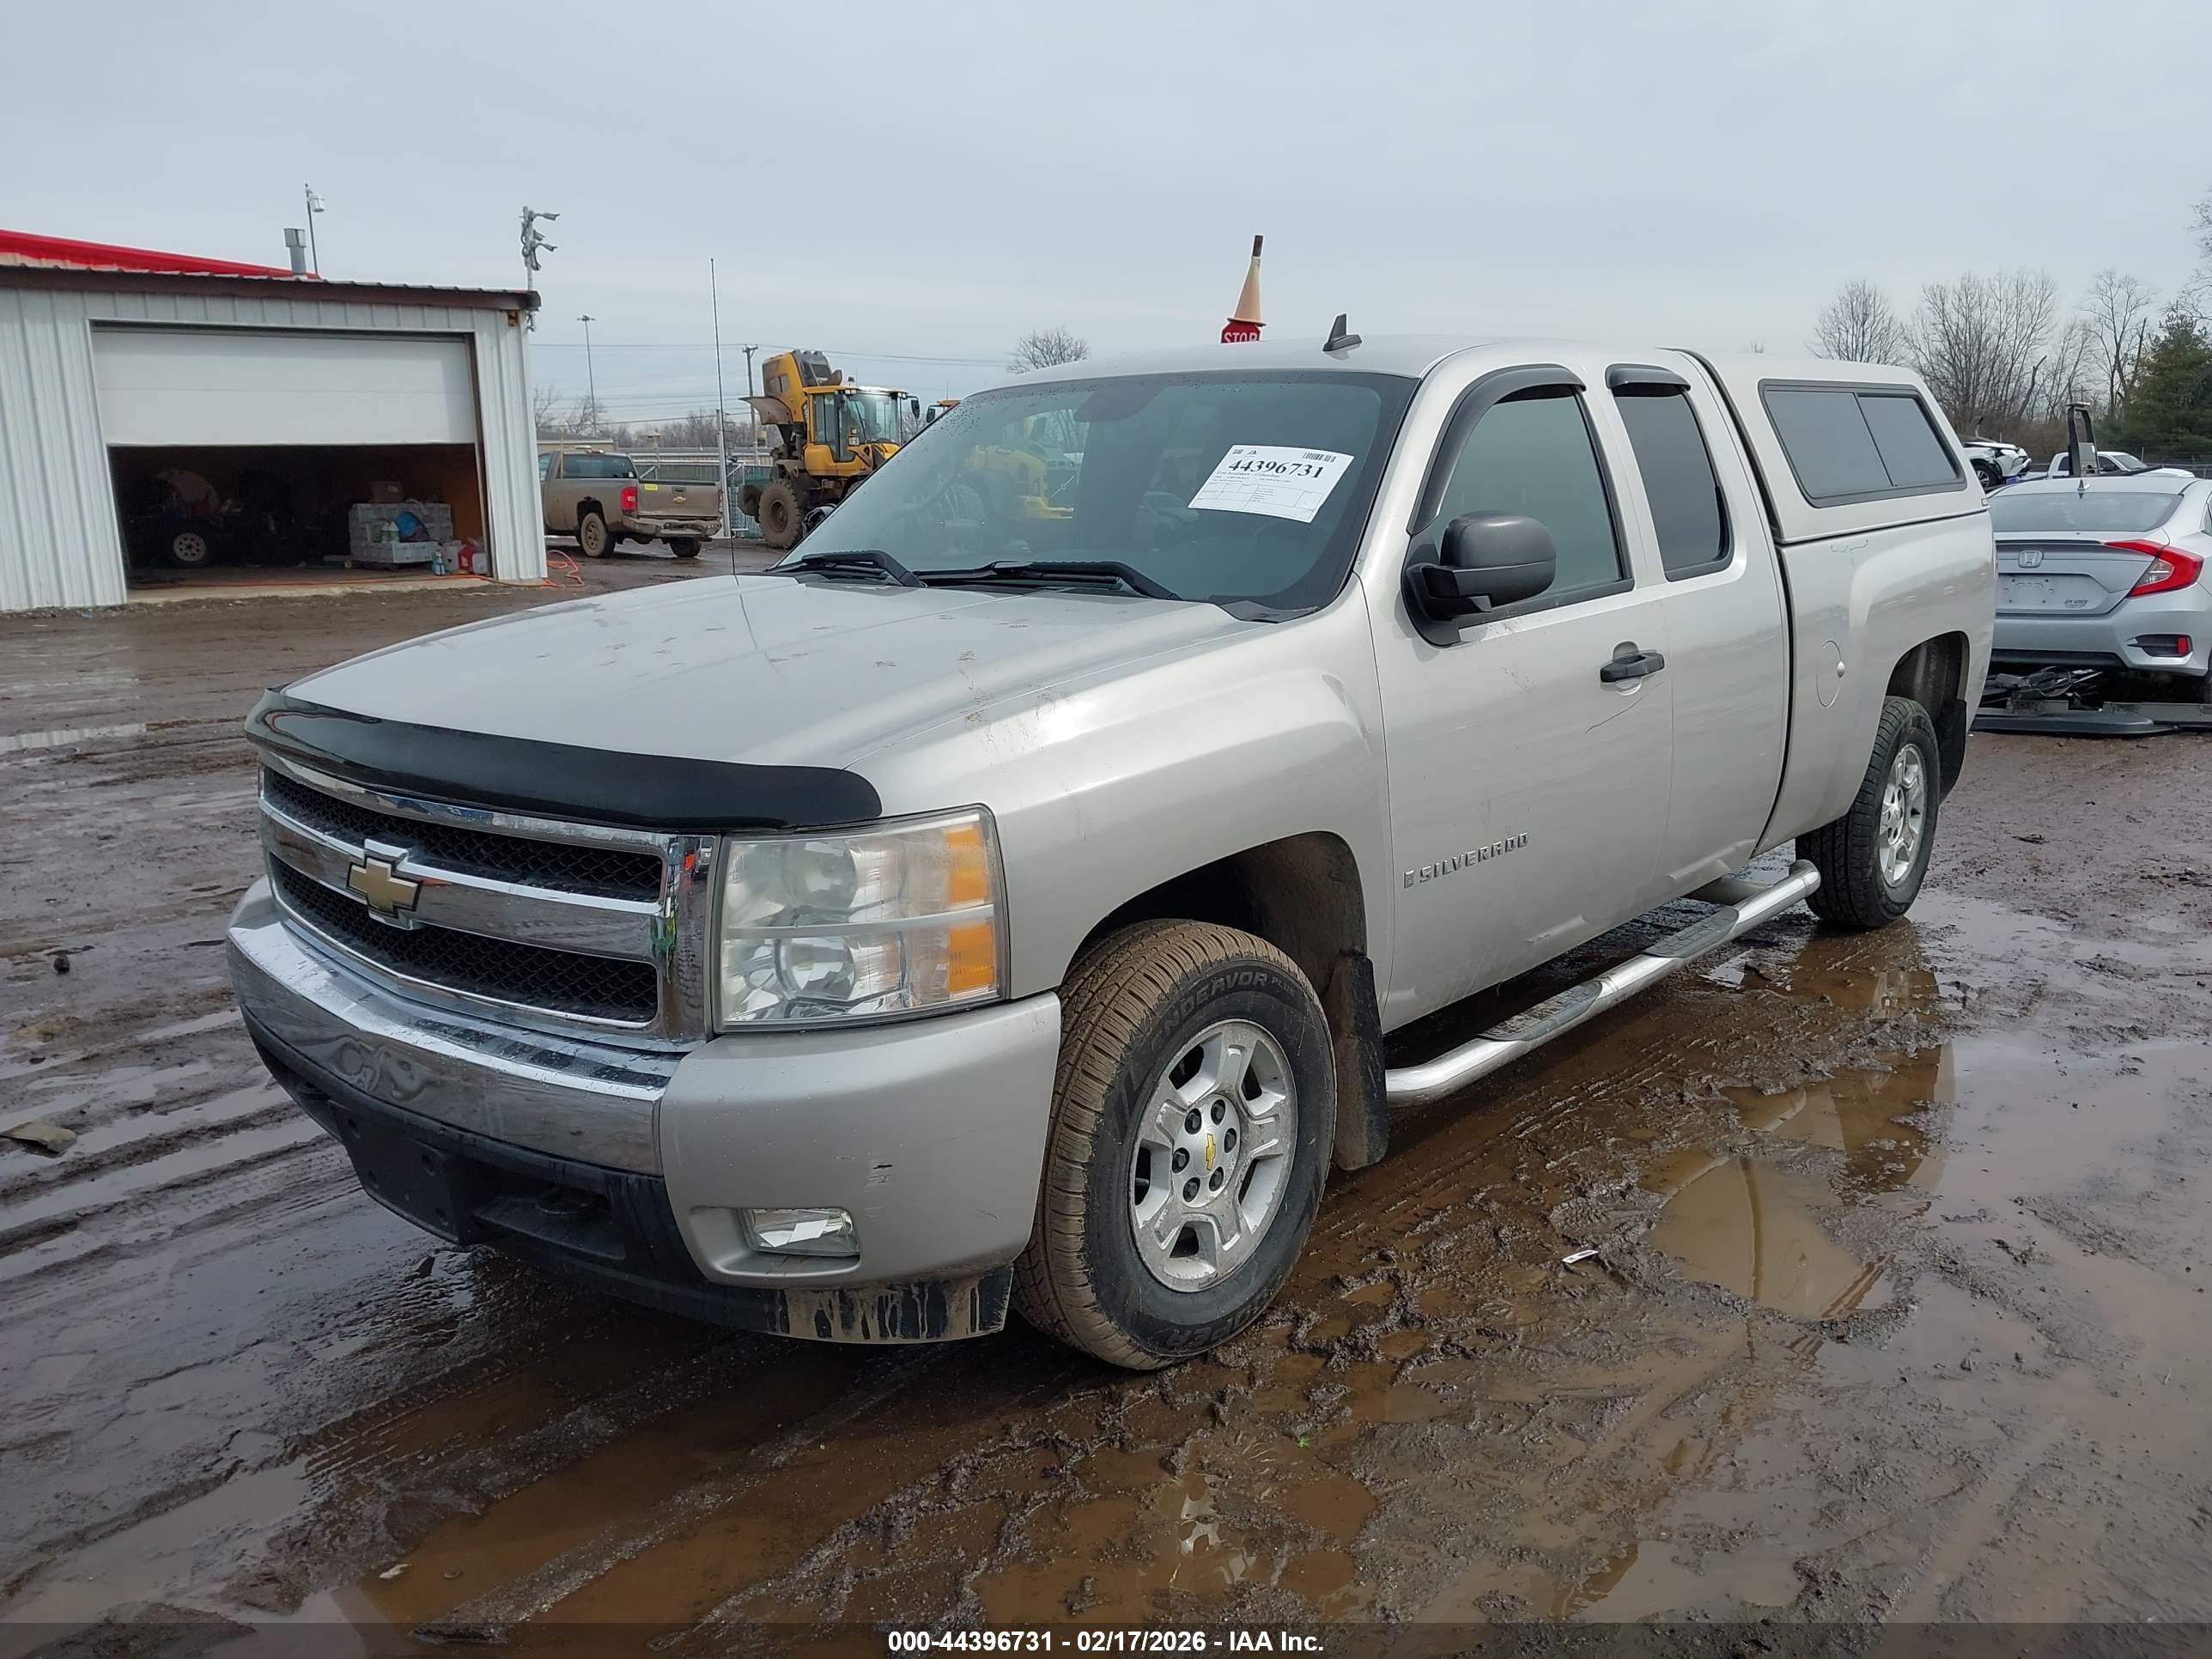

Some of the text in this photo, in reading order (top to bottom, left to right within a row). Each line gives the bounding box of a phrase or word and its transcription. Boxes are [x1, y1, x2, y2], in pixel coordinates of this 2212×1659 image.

[1224, 331, 1258, 343] STOP
[1229, 459, 1324, 479] 44396731
[1419, 832, 1529, 883] SILVERADO
[1159, 971, 1268, 1039] NDEAVOR
